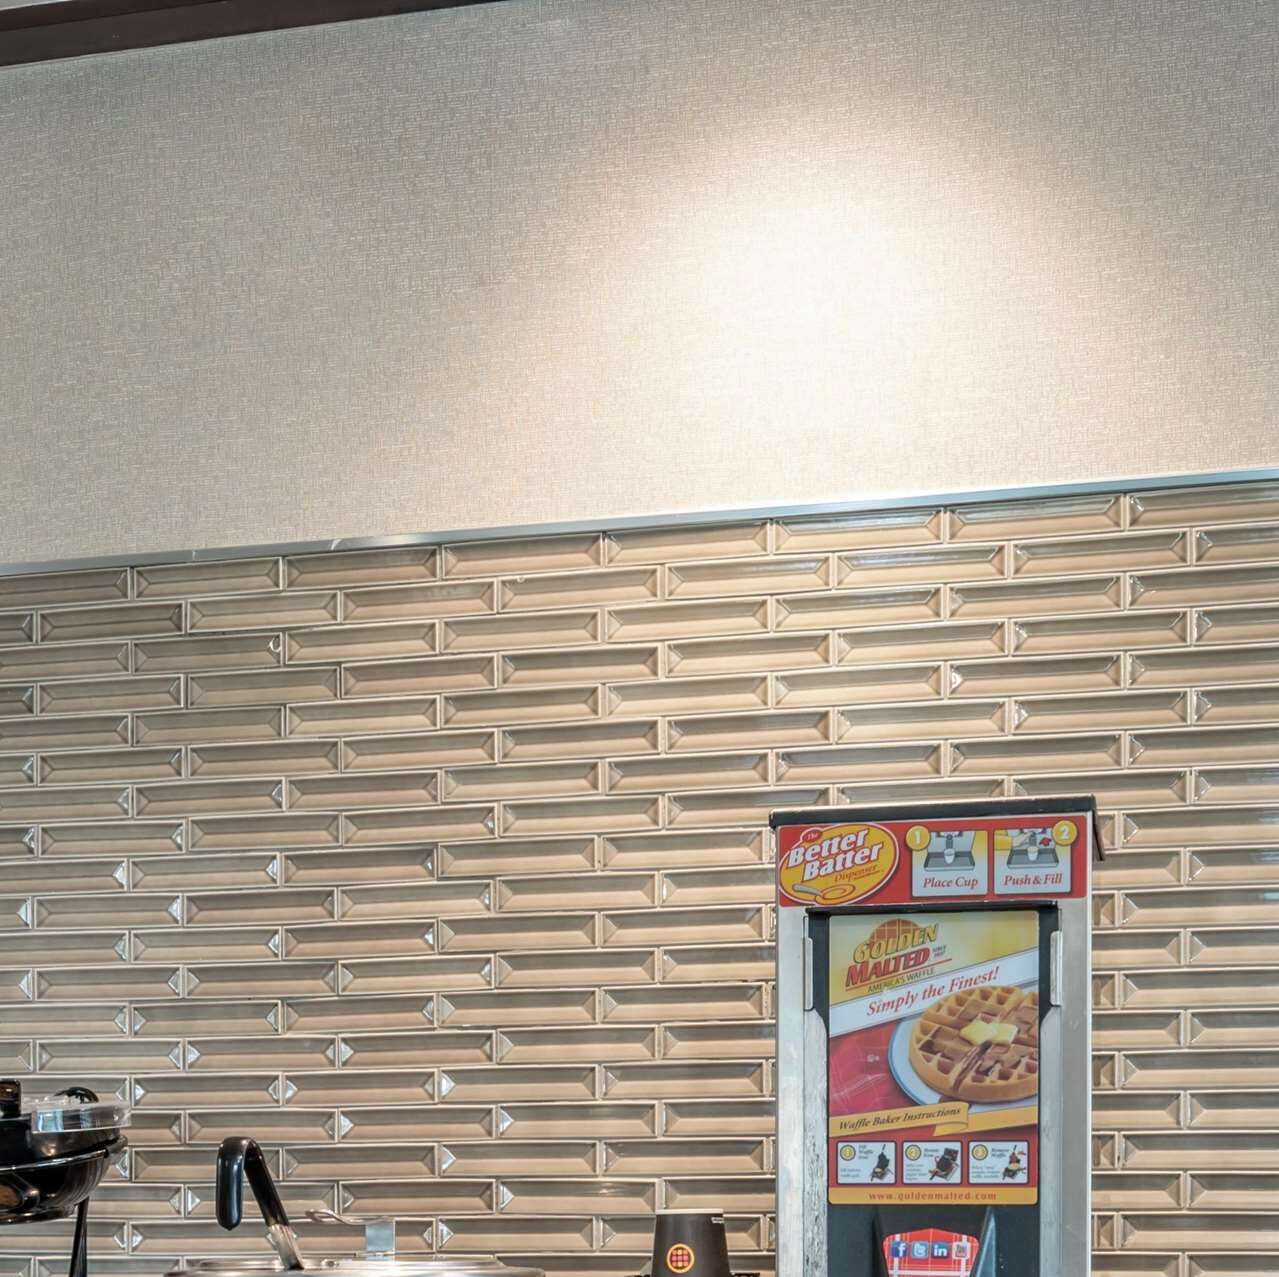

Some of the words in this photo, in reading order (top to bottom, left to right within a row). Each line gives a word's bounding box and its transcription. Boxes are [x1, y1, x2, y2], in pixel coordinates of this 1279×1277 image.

[787, 828, 870, 868] Better
[1059, 826, 1070, 840] 2
[802, 842, 884, 882] Batter
[923, 877, 952, 888] Place
[955, 876, 978, 889] Cup
[1004, 874, 1033, 886] Push
[1033, 876, 1041, 885] &
[1043, 873, 1062, 885] Fill
[853, 923, 939, 963] GOLDEN
[845, 947, 930, 987] MALTED
[867, 975, 905, 993] AMERICA'S
[906, 967, 935, 982] WAFFLE
[867, 991, 918, 1016] Simply
[922, 984, 944, 1000] the
[949, 966, 1000, 992] Finest!
[840, 1120, 871, 1130] Waffle
[873, 1116, 901, 1126] Baker
[903, 1108, 960, 1121] Instructions
